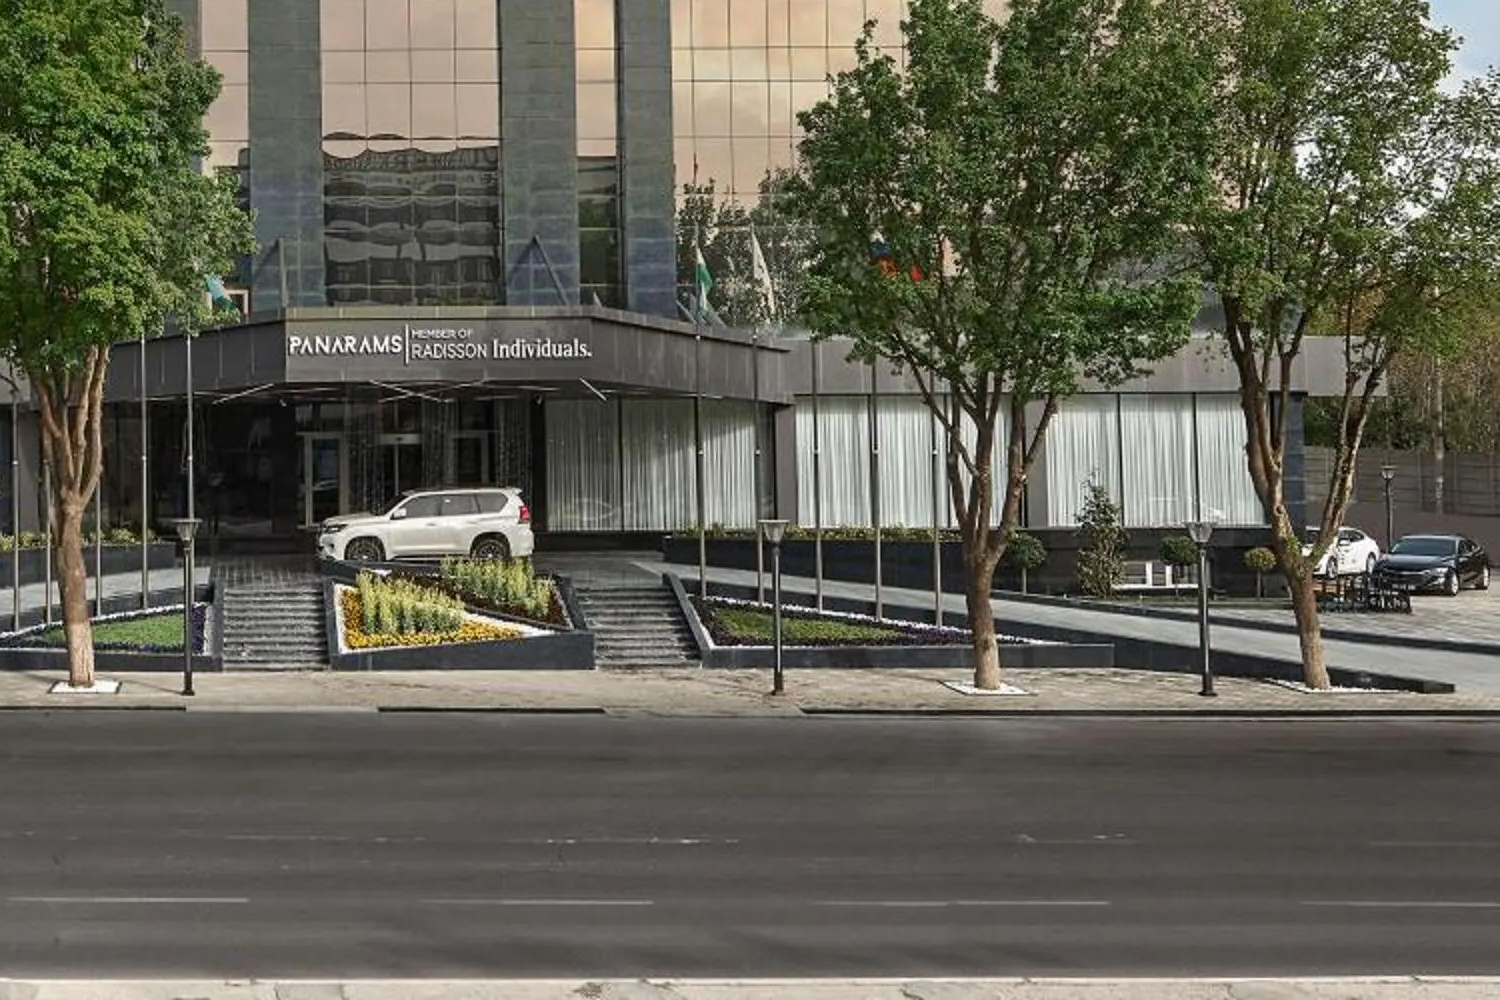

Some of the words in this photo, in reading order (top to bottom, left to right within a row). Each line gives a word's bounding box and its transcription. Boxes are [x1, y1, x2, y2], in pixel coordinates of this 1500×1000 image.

[288, 331, 403, 355] PANARAMS
[411, 328, 456, 339] MEMBER
[457, 328, 475, 339] OF
[411, 343, 488, 359] RADISSON
[492, 339, 593, 359] Individuals.
